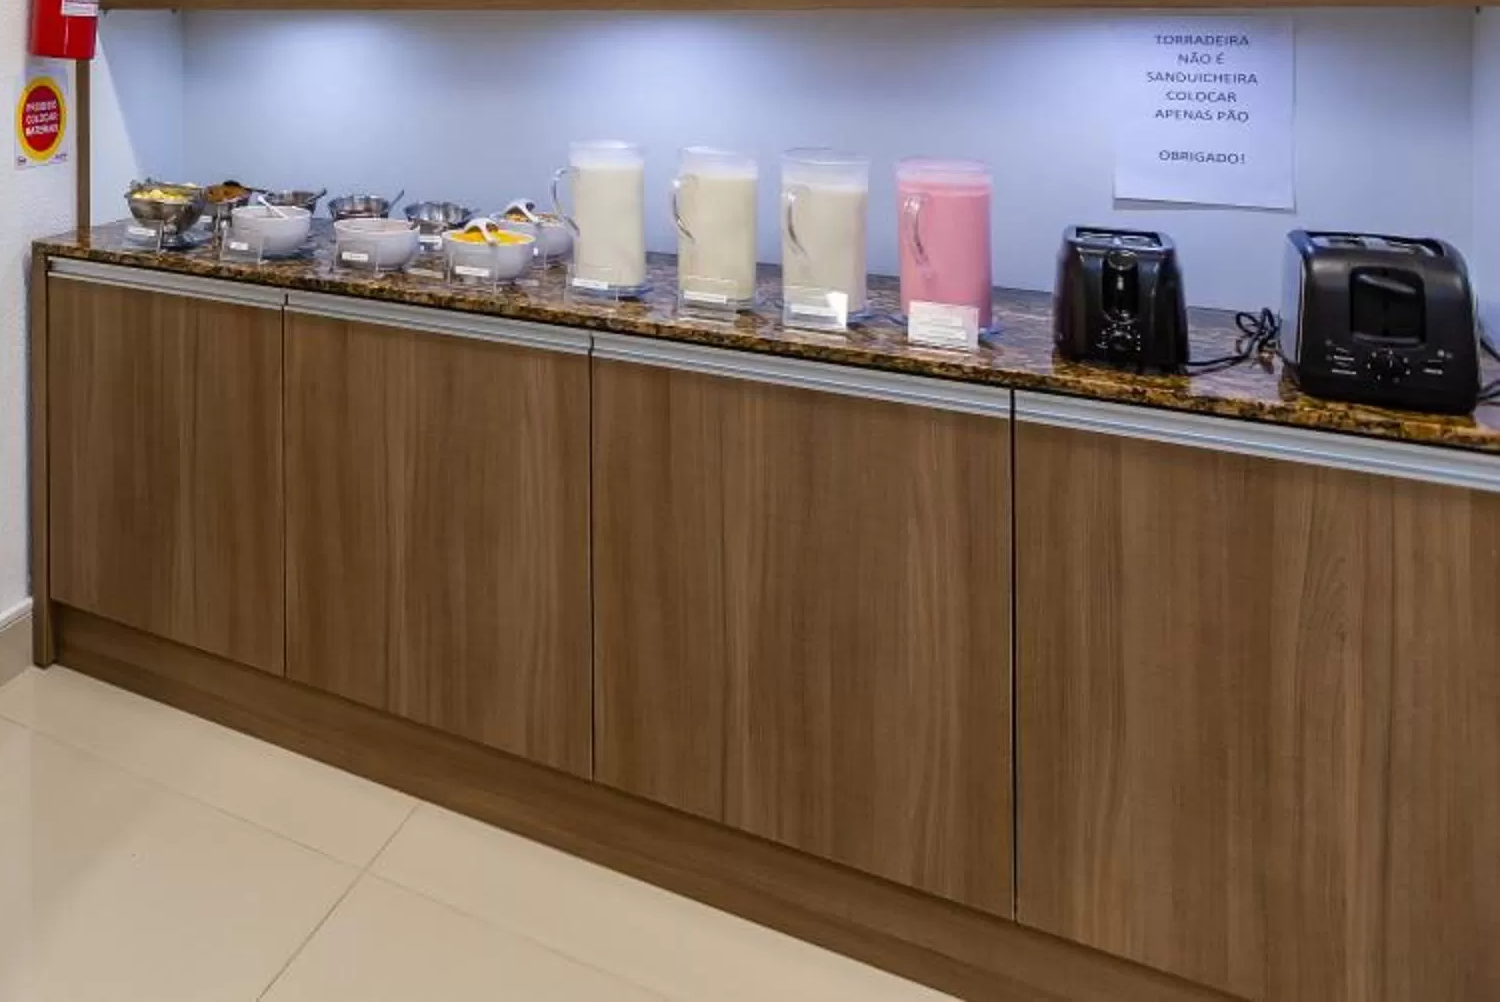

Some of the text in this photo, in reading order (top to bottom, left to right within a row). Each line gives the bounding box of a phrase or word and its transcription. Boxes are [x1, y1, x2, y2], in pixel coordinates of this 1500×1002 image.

[1154, 34, 1250, 47] TORRADEIRA
[1177, 52, 1225, 66] NÃO É
[1147, 71, 1258, 85] SANDUICHEIRA
[1165, 90, 1237, 103] COLOCAR
[1155, 109, 1249, 123] APENAS PÃO
[1158, 149, 1246, 165] OBRIGADO!
